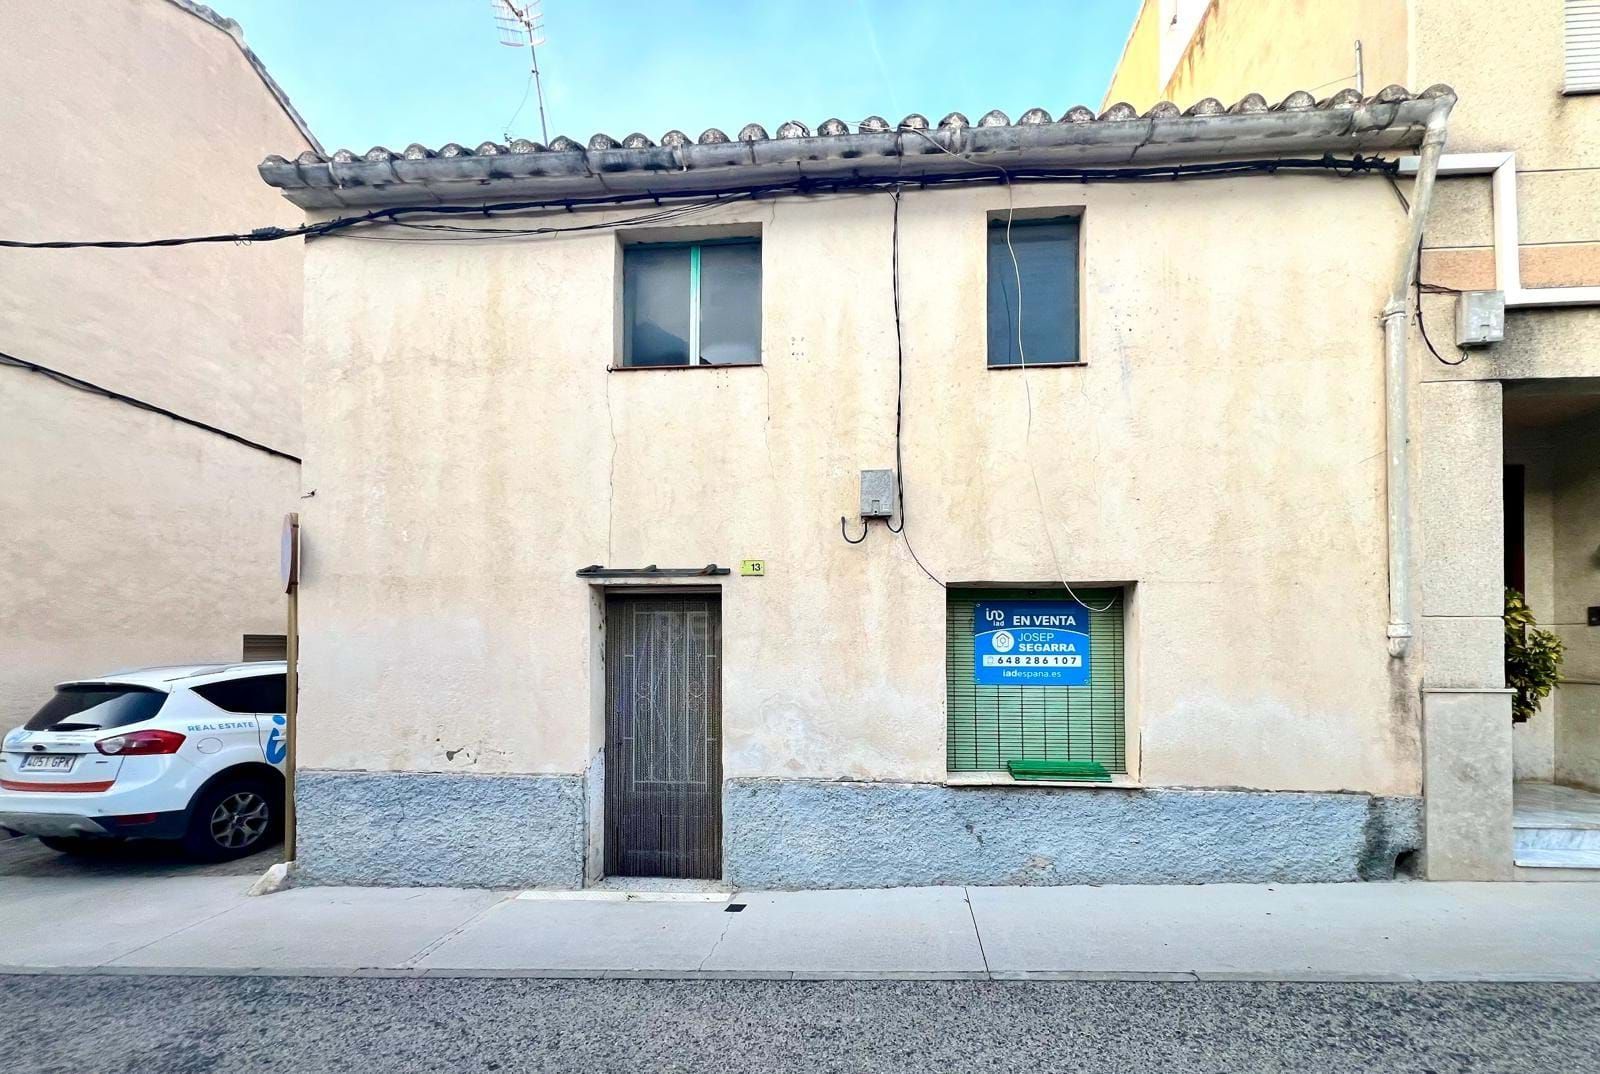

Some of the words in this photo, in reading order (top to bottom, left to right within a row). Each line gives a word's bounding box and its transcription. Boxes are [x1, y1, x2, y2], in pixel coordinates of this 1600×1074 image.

[751, 562, 761, 572] 13
[1013, 615, 1031, 626] EN
[1033, 615, 1077, 626] VENTA
[1017, 632, 1055, 642] JOSEP
[1018, 643, 1076, 652] SEGARRA
[997, 656, 1021, 665] 648
[1025, 656, 1049, 665] 286
[1054, 656, 1077, 665] 107
[187, 724, 216, 732] REAL
[218, 721, 255, 730] ESTATE
[51, 756, 73, 768] GPK
